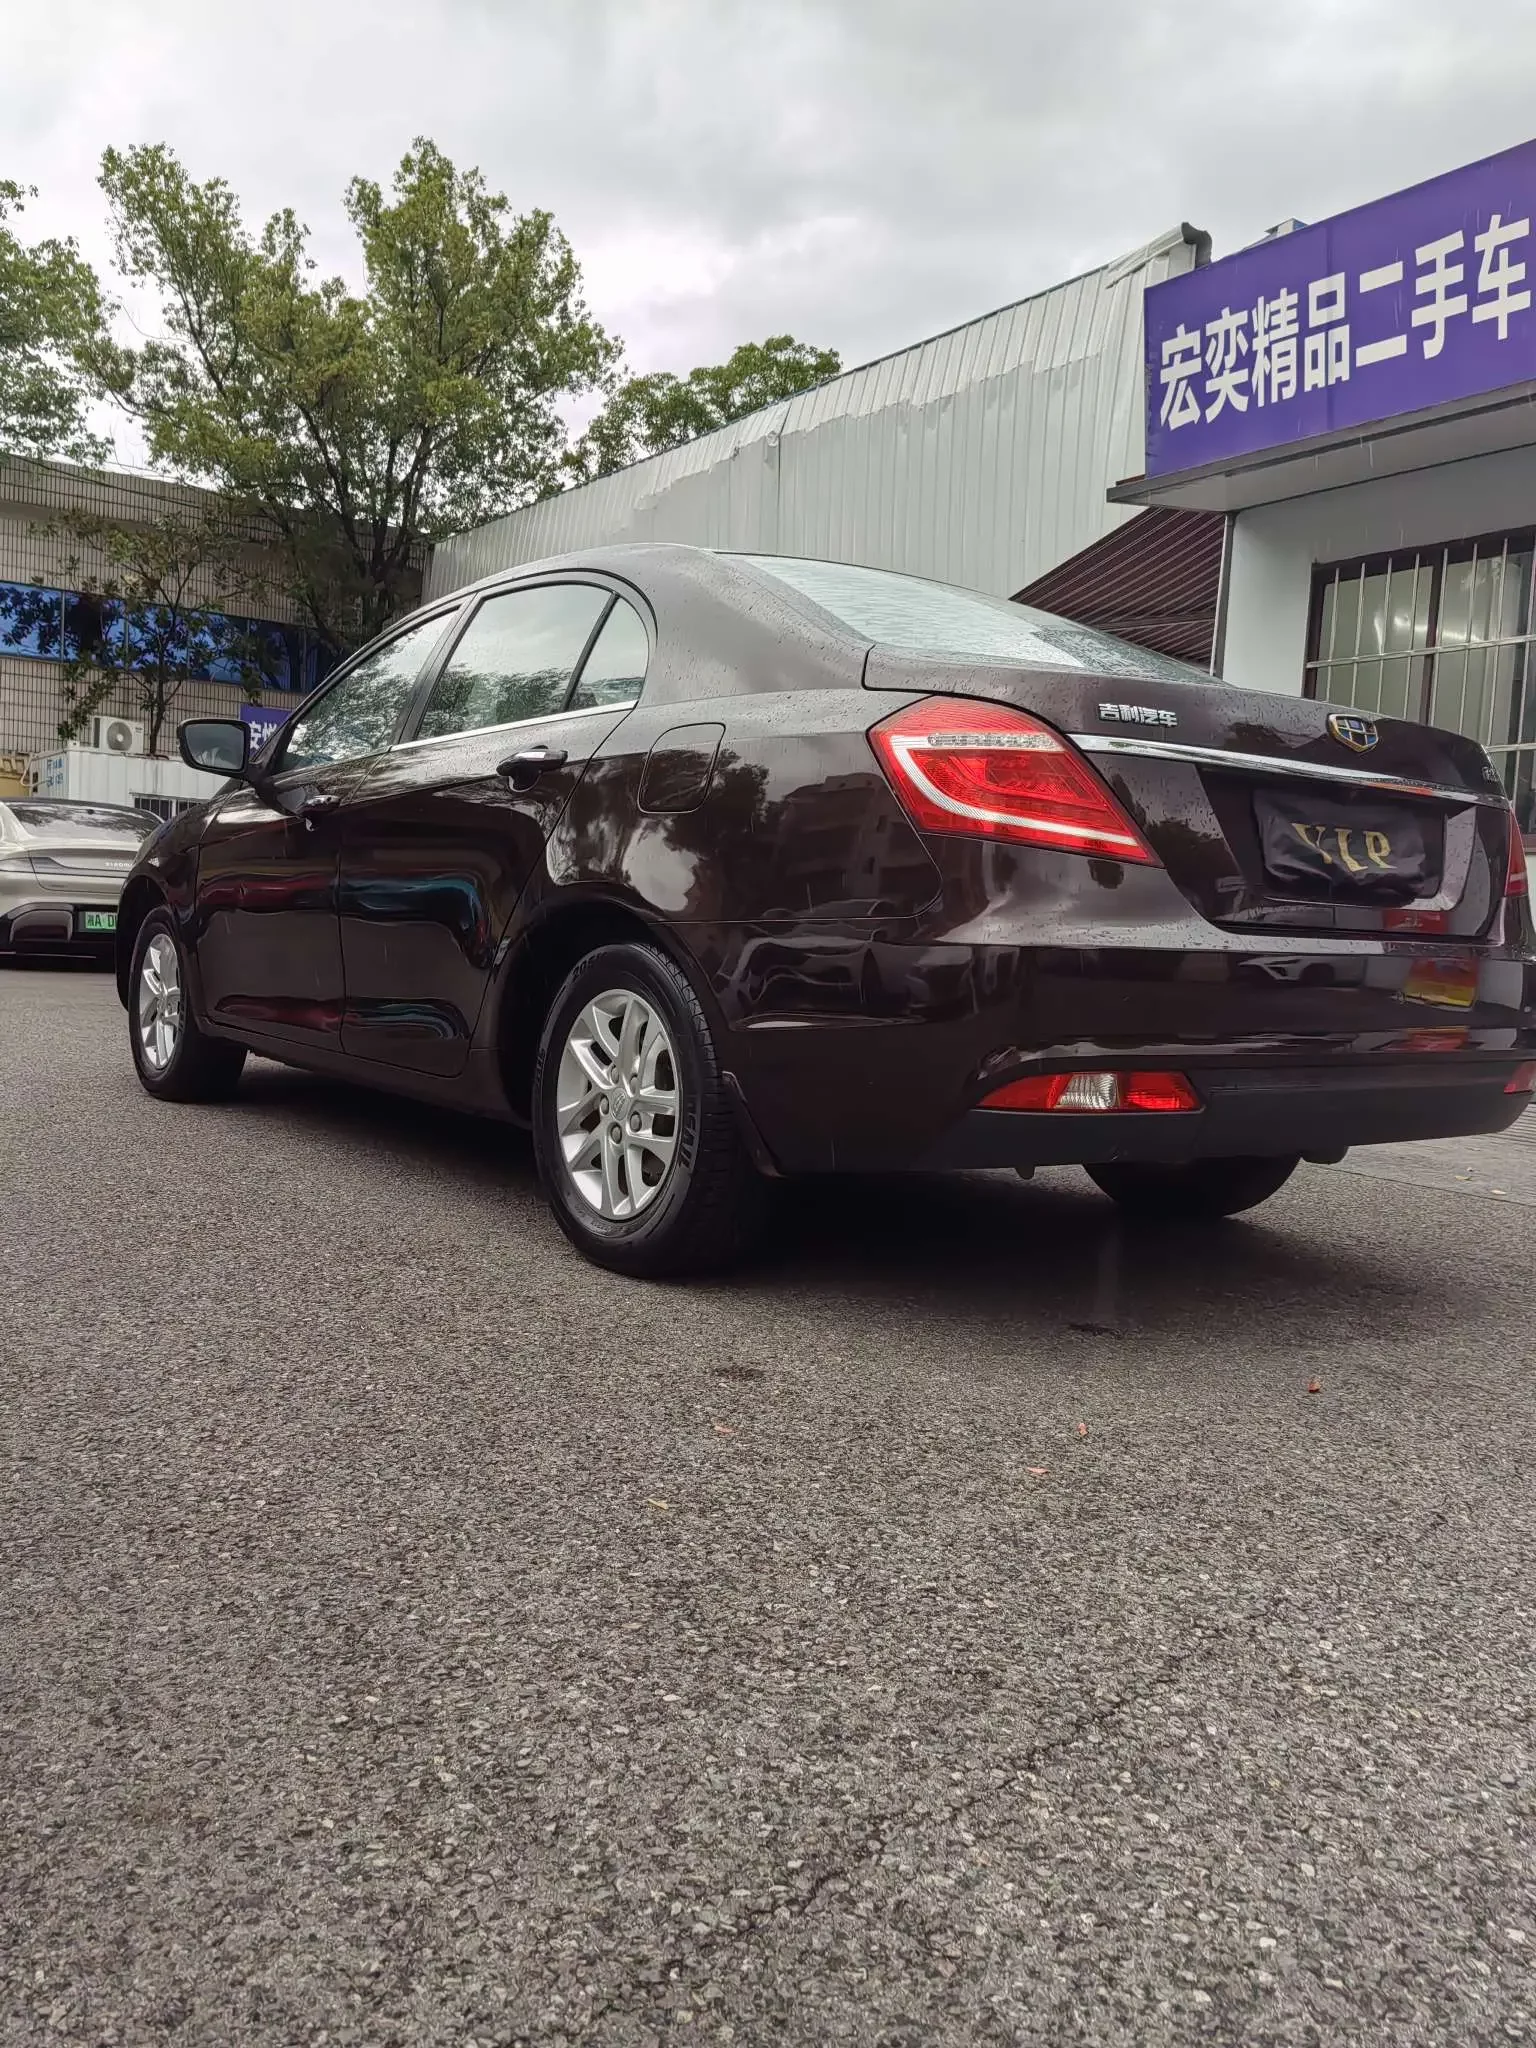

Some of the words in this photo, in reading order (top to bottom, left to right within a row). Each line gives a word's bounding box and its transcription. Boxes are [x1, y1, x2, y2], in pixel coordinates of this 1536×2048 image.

[1160, 214, 1532, 431] 宏奕精品二手车
[1098, 703, 1178, 727] 吉利汽车
[1291, 822, 1398, 872] VIP
